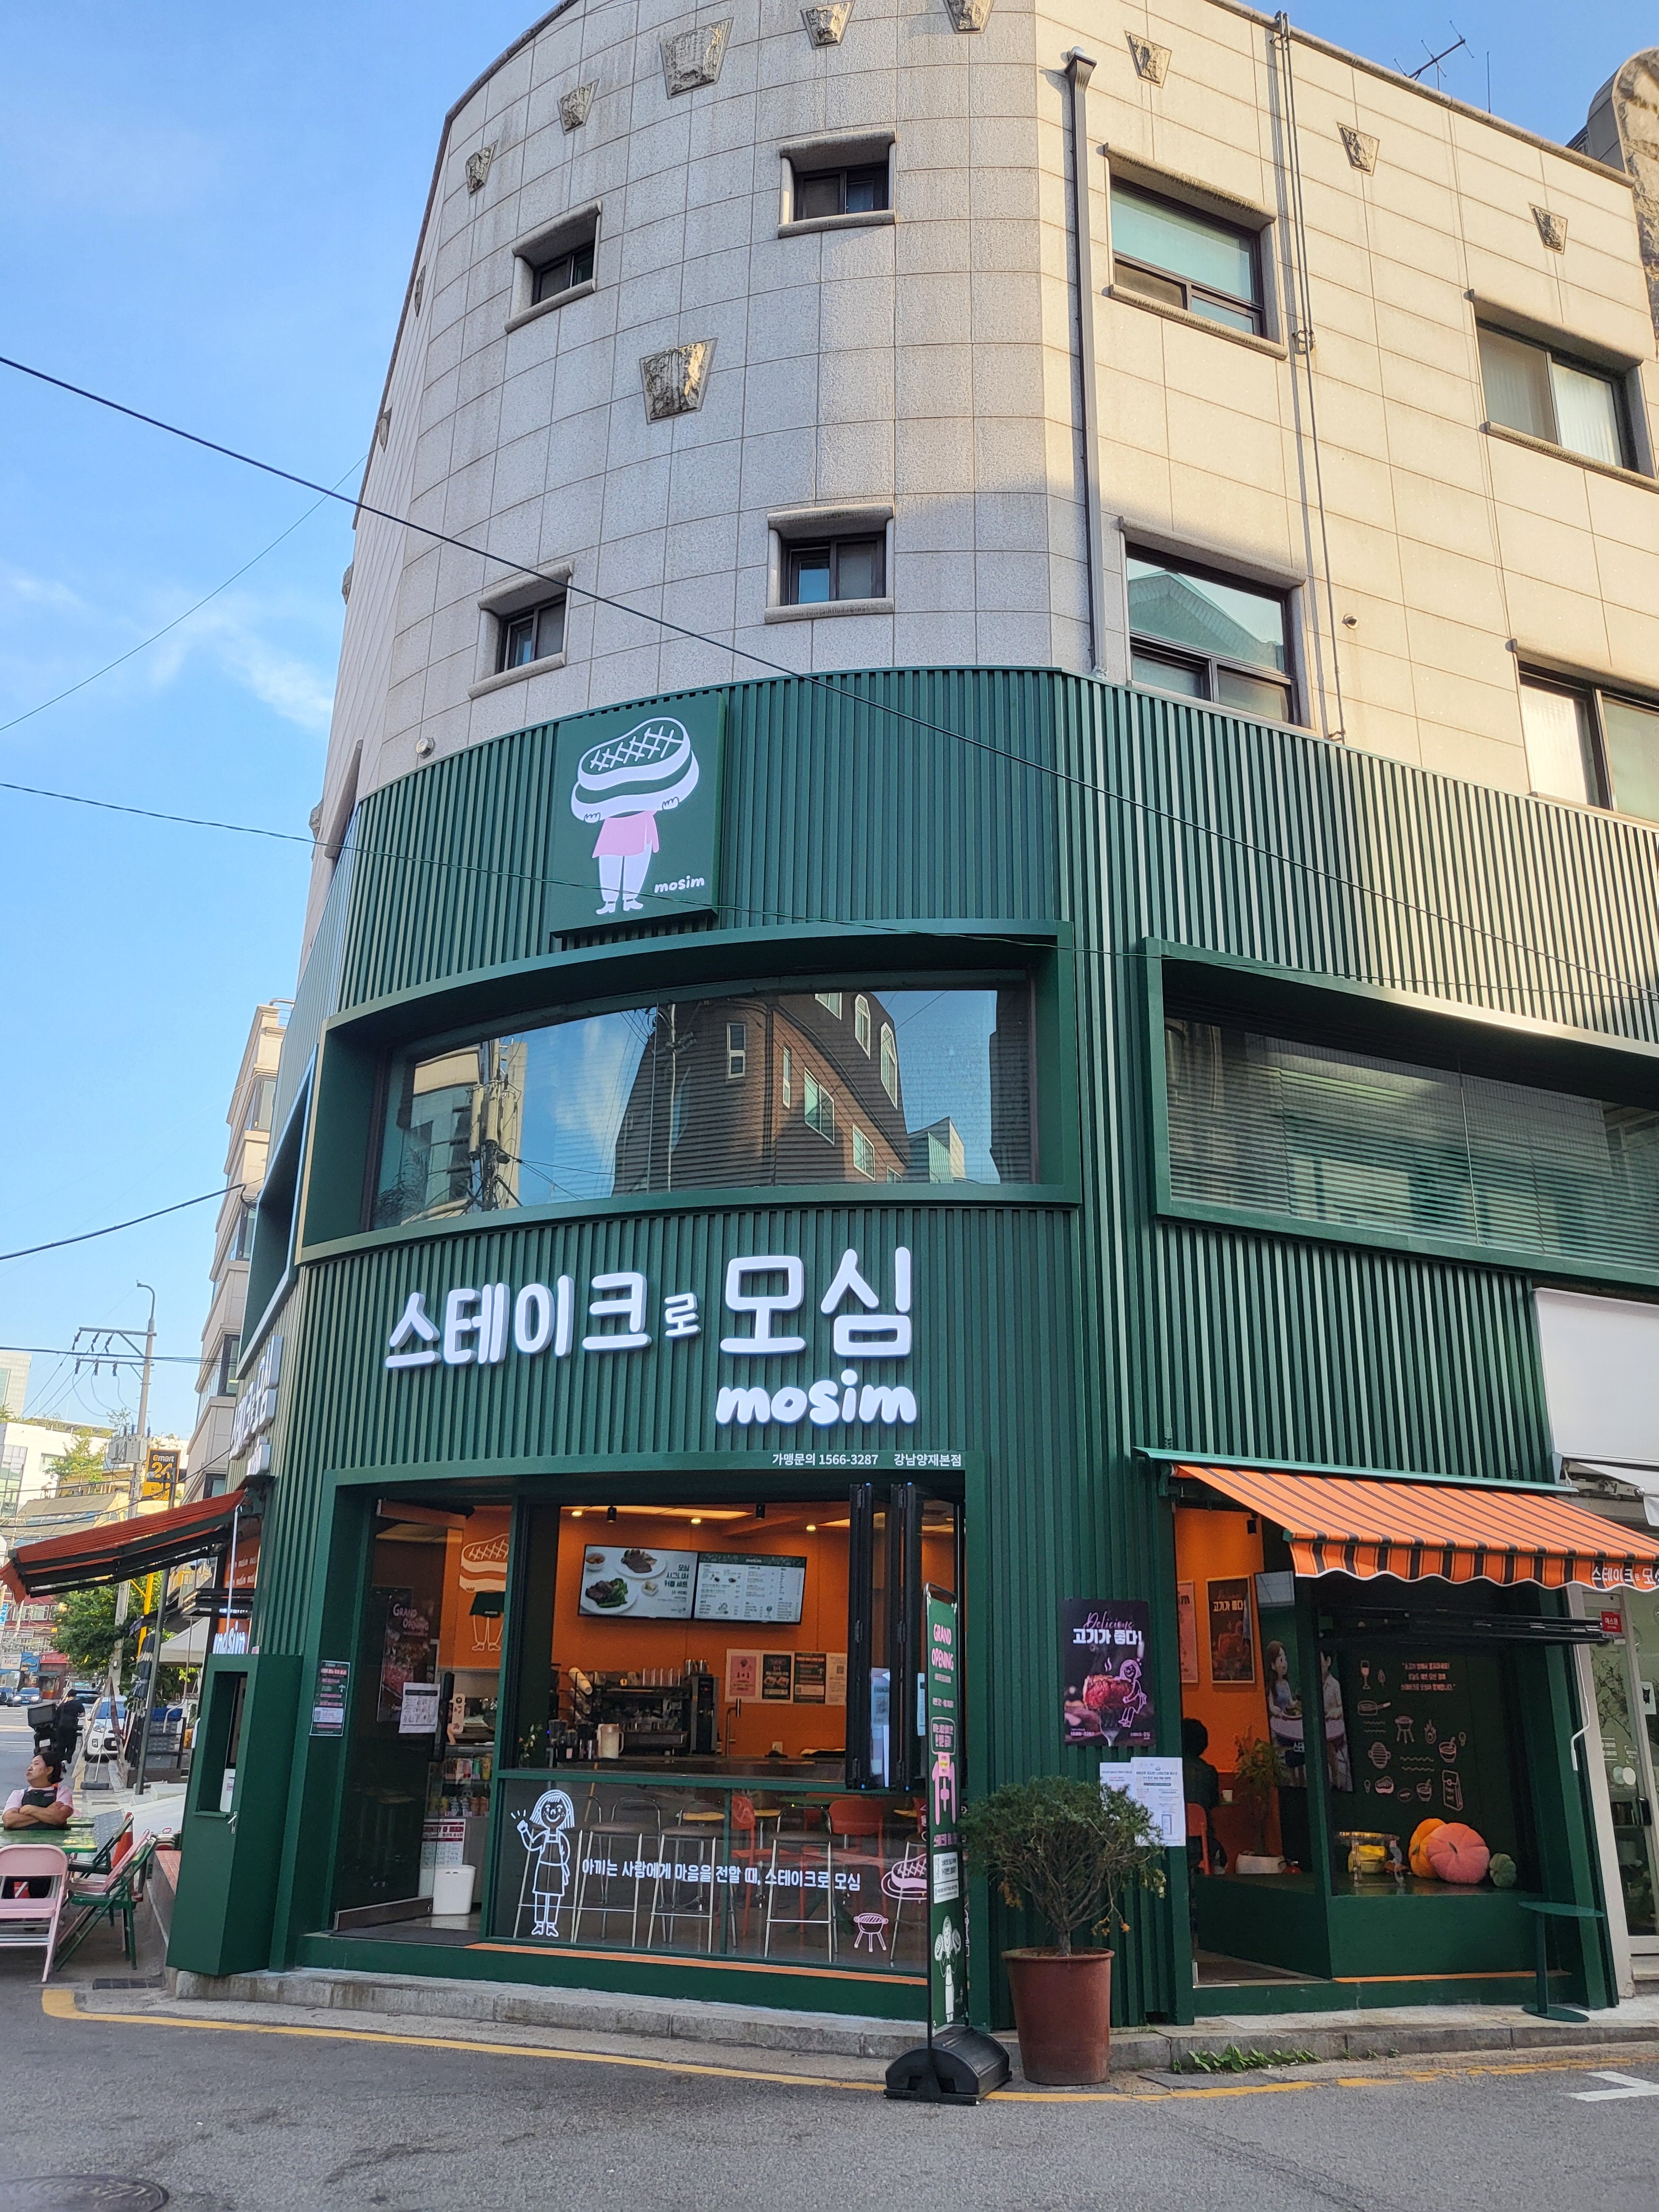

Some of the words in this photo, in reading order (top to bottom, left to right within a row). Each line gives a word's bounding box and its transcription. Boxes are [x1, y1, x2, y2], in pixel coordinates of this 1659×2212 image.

[654, 875, 705, 894] mosim
[385, 1271, 702, 1369] 스테이크로
[720, 1246, 912, 1358] 모심
[716, 1369, 917, 1425] mosim
[153, 1454, 175, 1463] emart
[772, 1454, 816, 1467] 가맹문의
[819, 1454, 879, 1466] 1566-3287
[894, 1454, 962, 1467] 강남양재본점
[933, 1623, 952, 1646] GRAND
[1073, 1628, 1112, 1645] 고기가
[1114, 1629, 1142, 1645] 좋다!
[931, 1647, 954, 1671] OPENING
[582, 1858, 618, 1876] 아끼는
[622, 1860, 671, 1880] 사람에게
[674, 1863, 711, 1883] 마음을
[716, 1865, 741, 1885] 전할
[764, 1868, 830, 1889] 스테이크로
[834, 1872, 860, 1891] 모심
